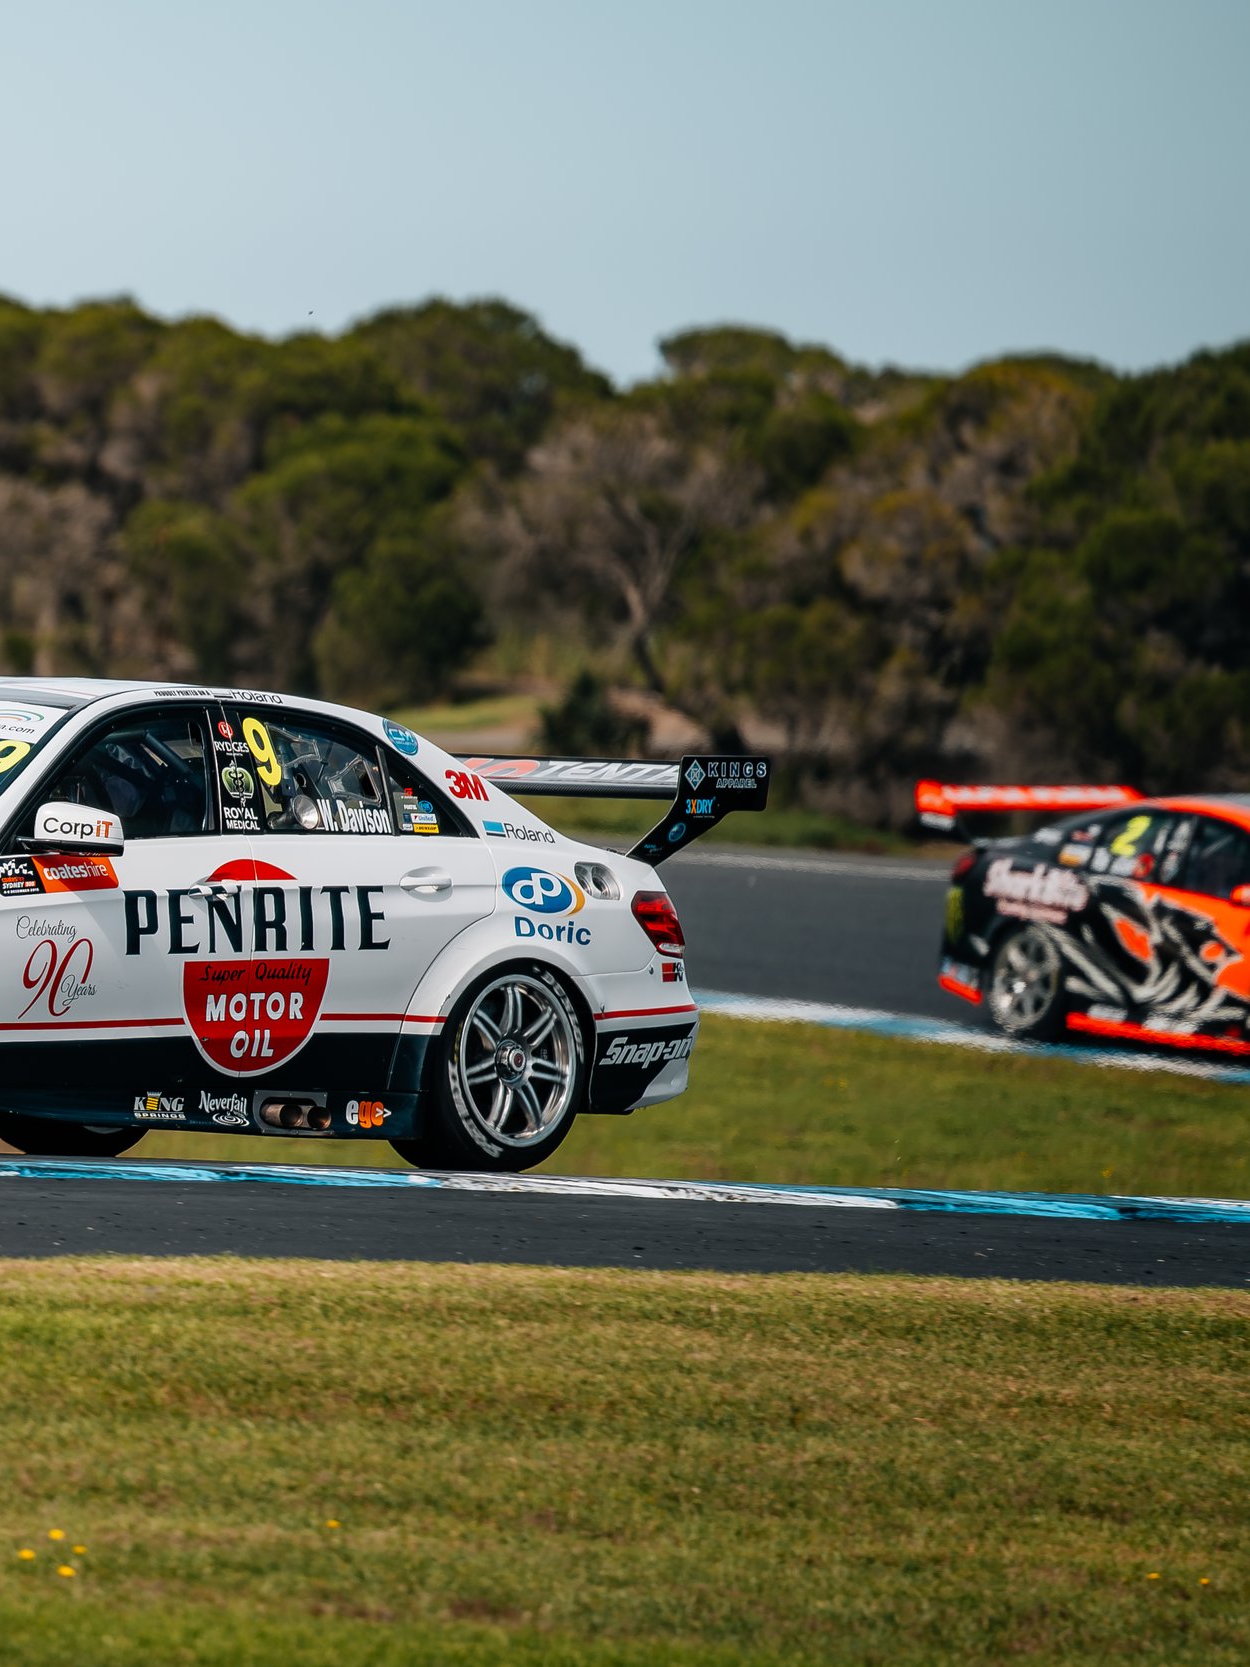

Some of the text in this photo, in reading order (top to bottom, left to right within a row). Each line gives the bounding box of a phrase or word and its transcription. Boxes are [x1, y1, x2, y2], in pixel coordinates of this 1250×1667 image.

[213, 741, 250, 753] RYDGES
[242, 717, 282, 786] 9
[537, 761, 680, 781] TENT
[707, 762, 767, 779] KINGS
[716, 778, 757, 789] APPAREL
[445, 769, 490, 802] 3M
[223, 806, 258, 820] ROYAL
[226, 819, 261, 831] MEDICAL
[316, 799, 393, 834] W. Davison
[503, 822, 556, 844] Roland
[1111, 815, 1152, 858] 2
[16, 915, 78, 944] Celebrating
[122, 886, 392, 956] PENRITE
[514, 916, 592, 946] Doric
[199, 961, 313, 986] Super Quality
[60, 974, 98, 1007] Years
[205, 991, 304, 1022] MOTOR
[230, 1029, 275, 1059] OIL
[599, 1036, 694, 1069] Snap-on
[134, 1112, 186, 1120] SPRINGS
[198, 1090, 248, 1116] Neverfail
